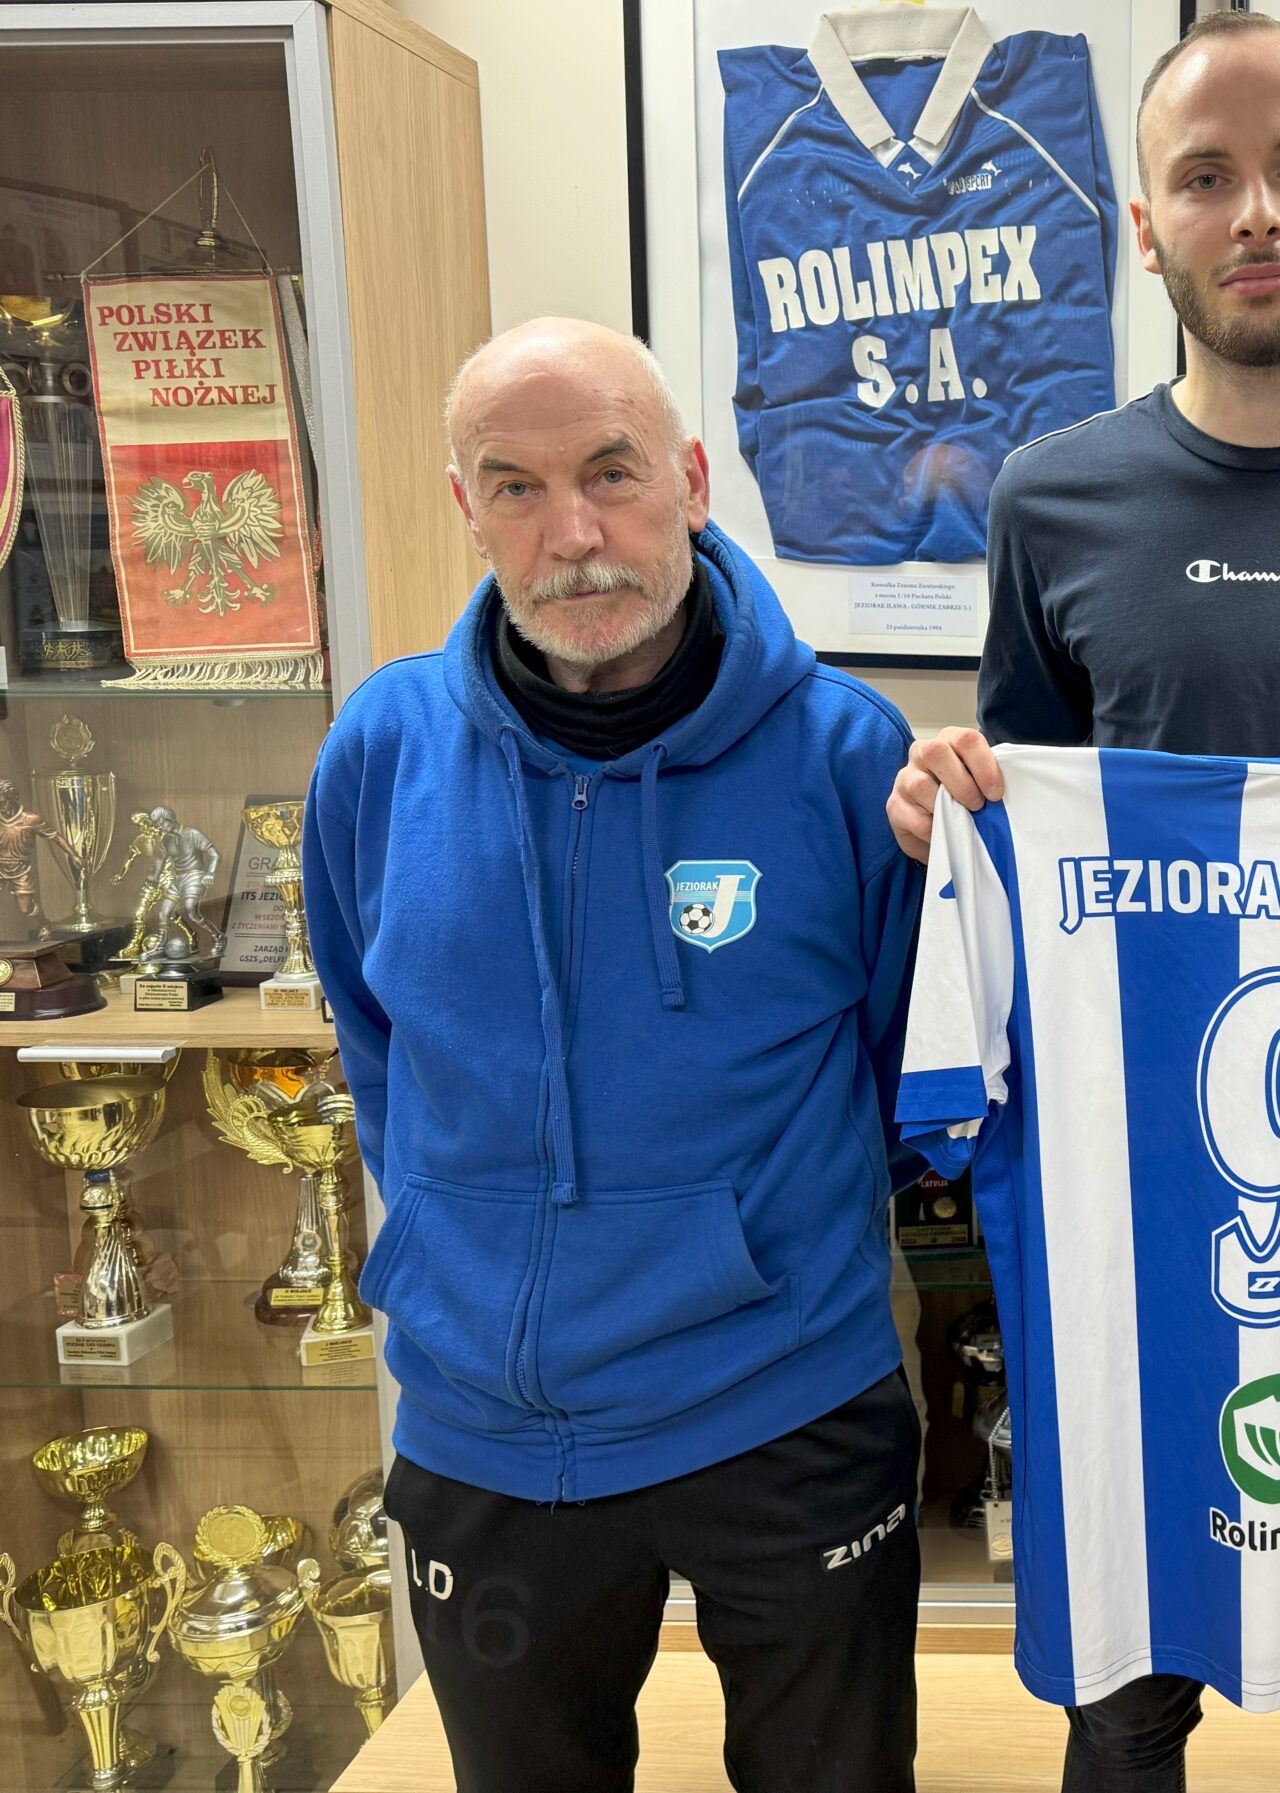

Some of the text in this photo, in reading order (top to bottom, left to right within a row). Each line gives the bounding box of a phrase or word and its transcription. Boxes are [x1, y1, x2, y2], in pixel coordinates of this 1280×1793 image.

[758, 225, 1041, 333] ROLIMPEX
[96, 302, 214, 326] POLSKI
[113, 329, 266, 357] ZWIĄZEK
[132, 357, 226, 380] PIŁKI
[851, 328, 988, 409] S.A.
[149, 380, 277, 408] NOŻNEJ
[241, 891, 256, 901] ITS
[676, 882, 719, 891] JEZIORAK
[254, 945, 284, 954] ZARZĄD
[921, 1179, 949, 1188] LATVIJA
